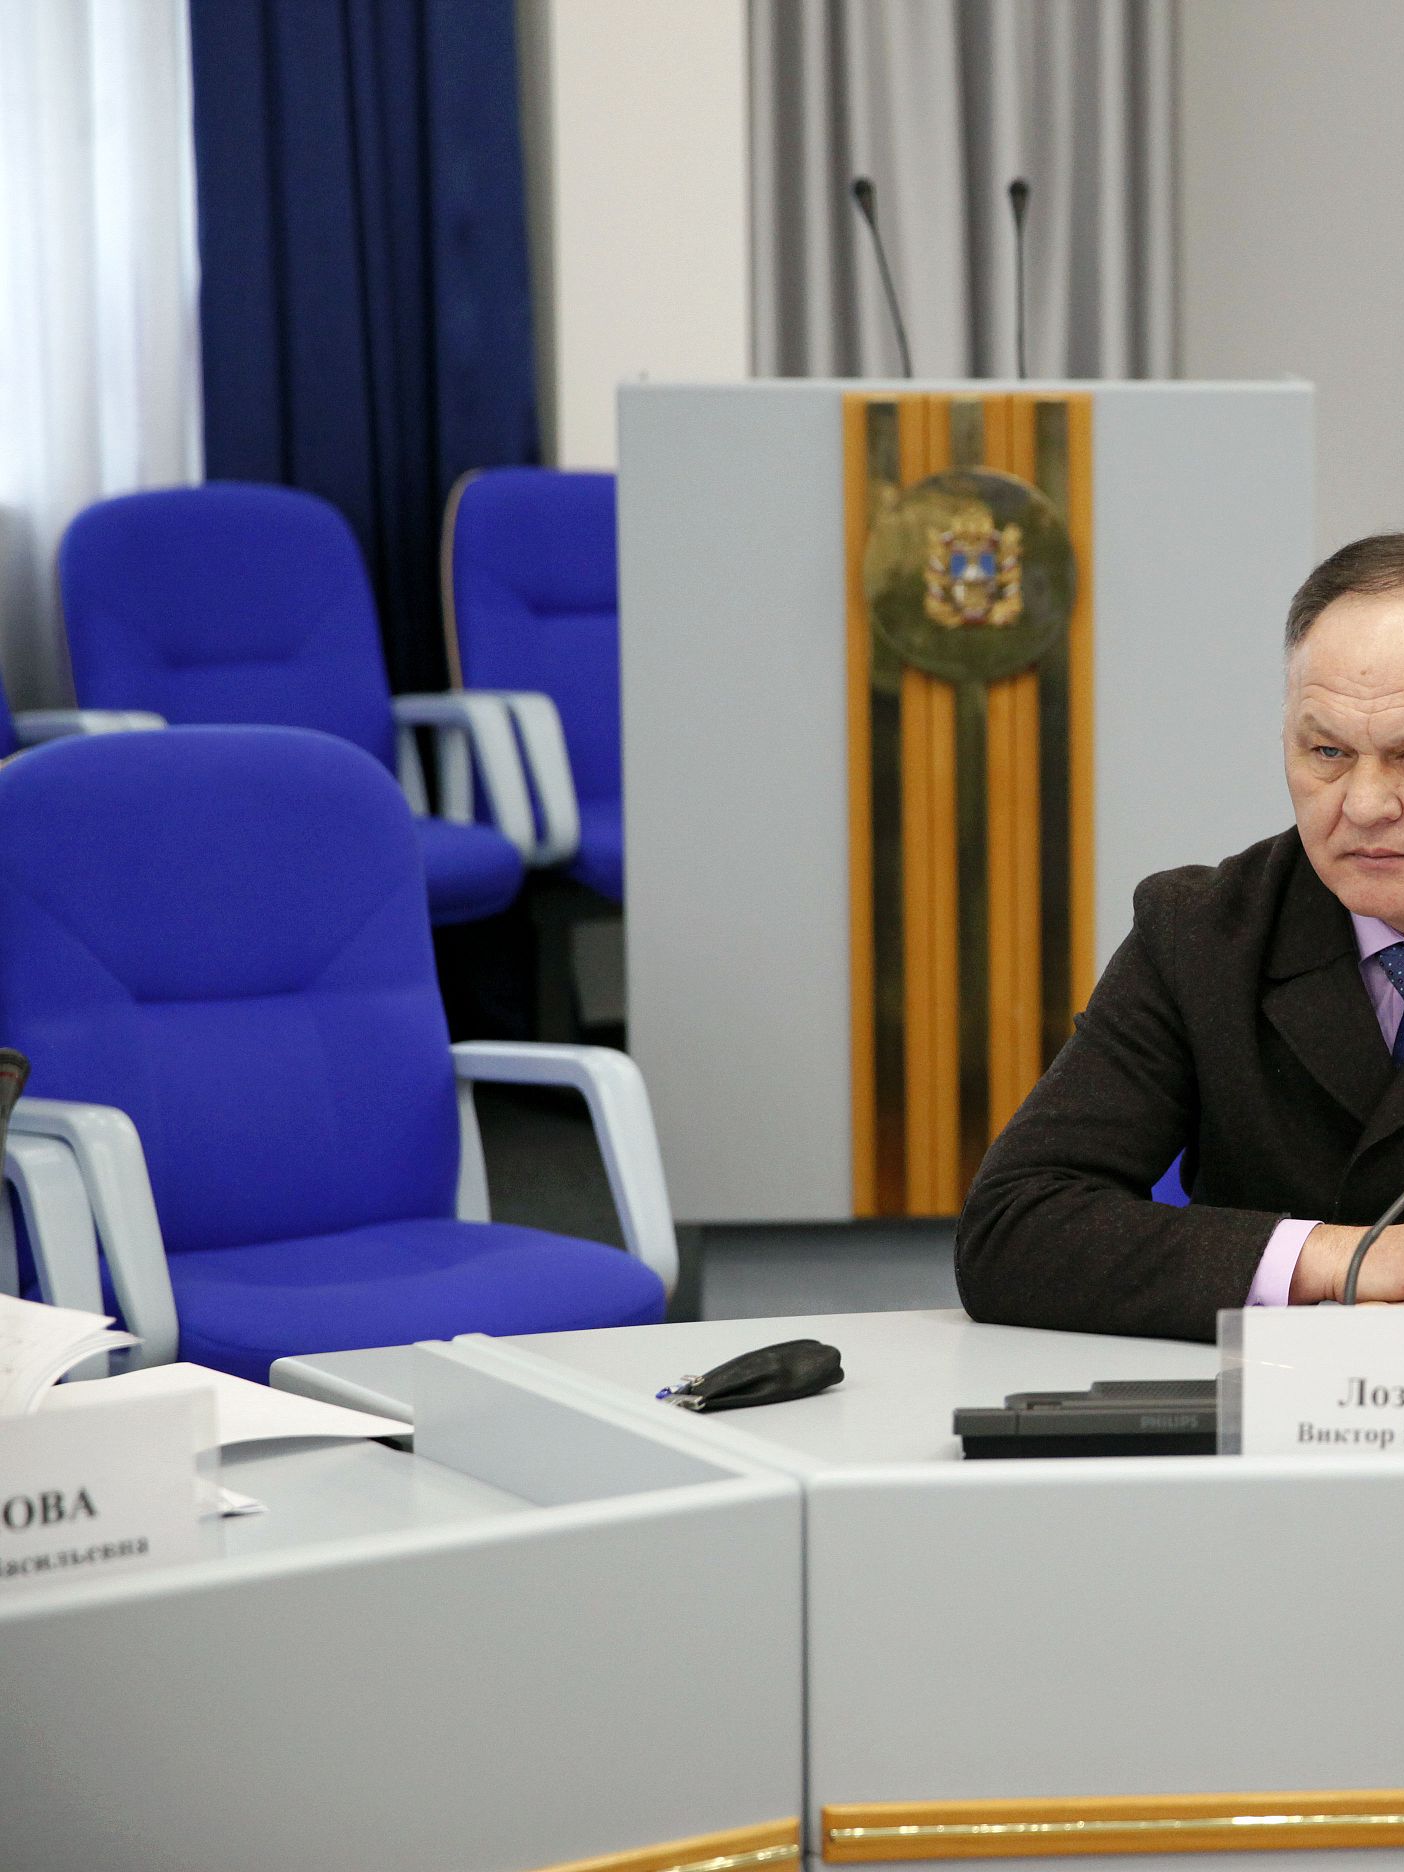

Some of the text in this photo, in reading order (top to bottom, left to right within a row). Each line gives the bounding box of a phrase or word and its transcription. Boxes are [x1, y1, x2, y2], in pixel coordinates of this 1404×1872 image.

[1297, 1422, 1395, 1450] Виктор
[0, 1487, 98, 1532] ОВА
[0, 1536, 149, 1578] асильевна
